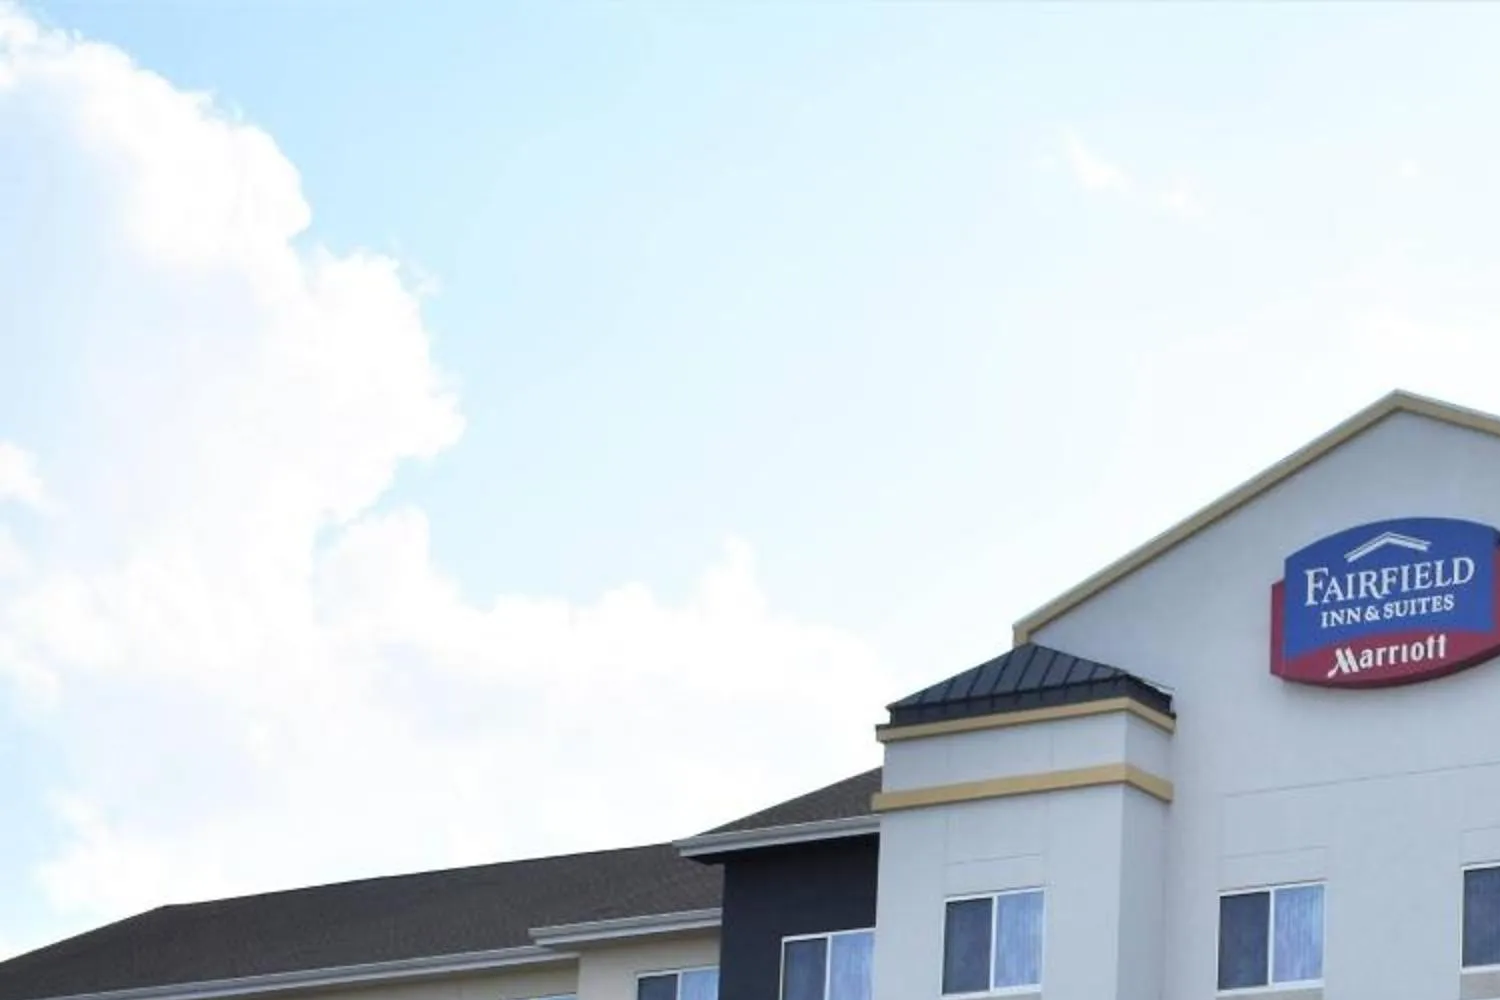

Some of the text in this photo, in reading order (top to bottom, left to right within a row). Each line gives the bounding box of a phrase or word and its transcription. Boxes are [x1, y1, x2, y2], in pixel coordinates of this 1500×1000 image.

[1304, 556, 1475, 606] FAIRFIELD
[1321, 594, 1455, 628] INN & SUITES
[1327, 634, 1447, 678] Marriott
